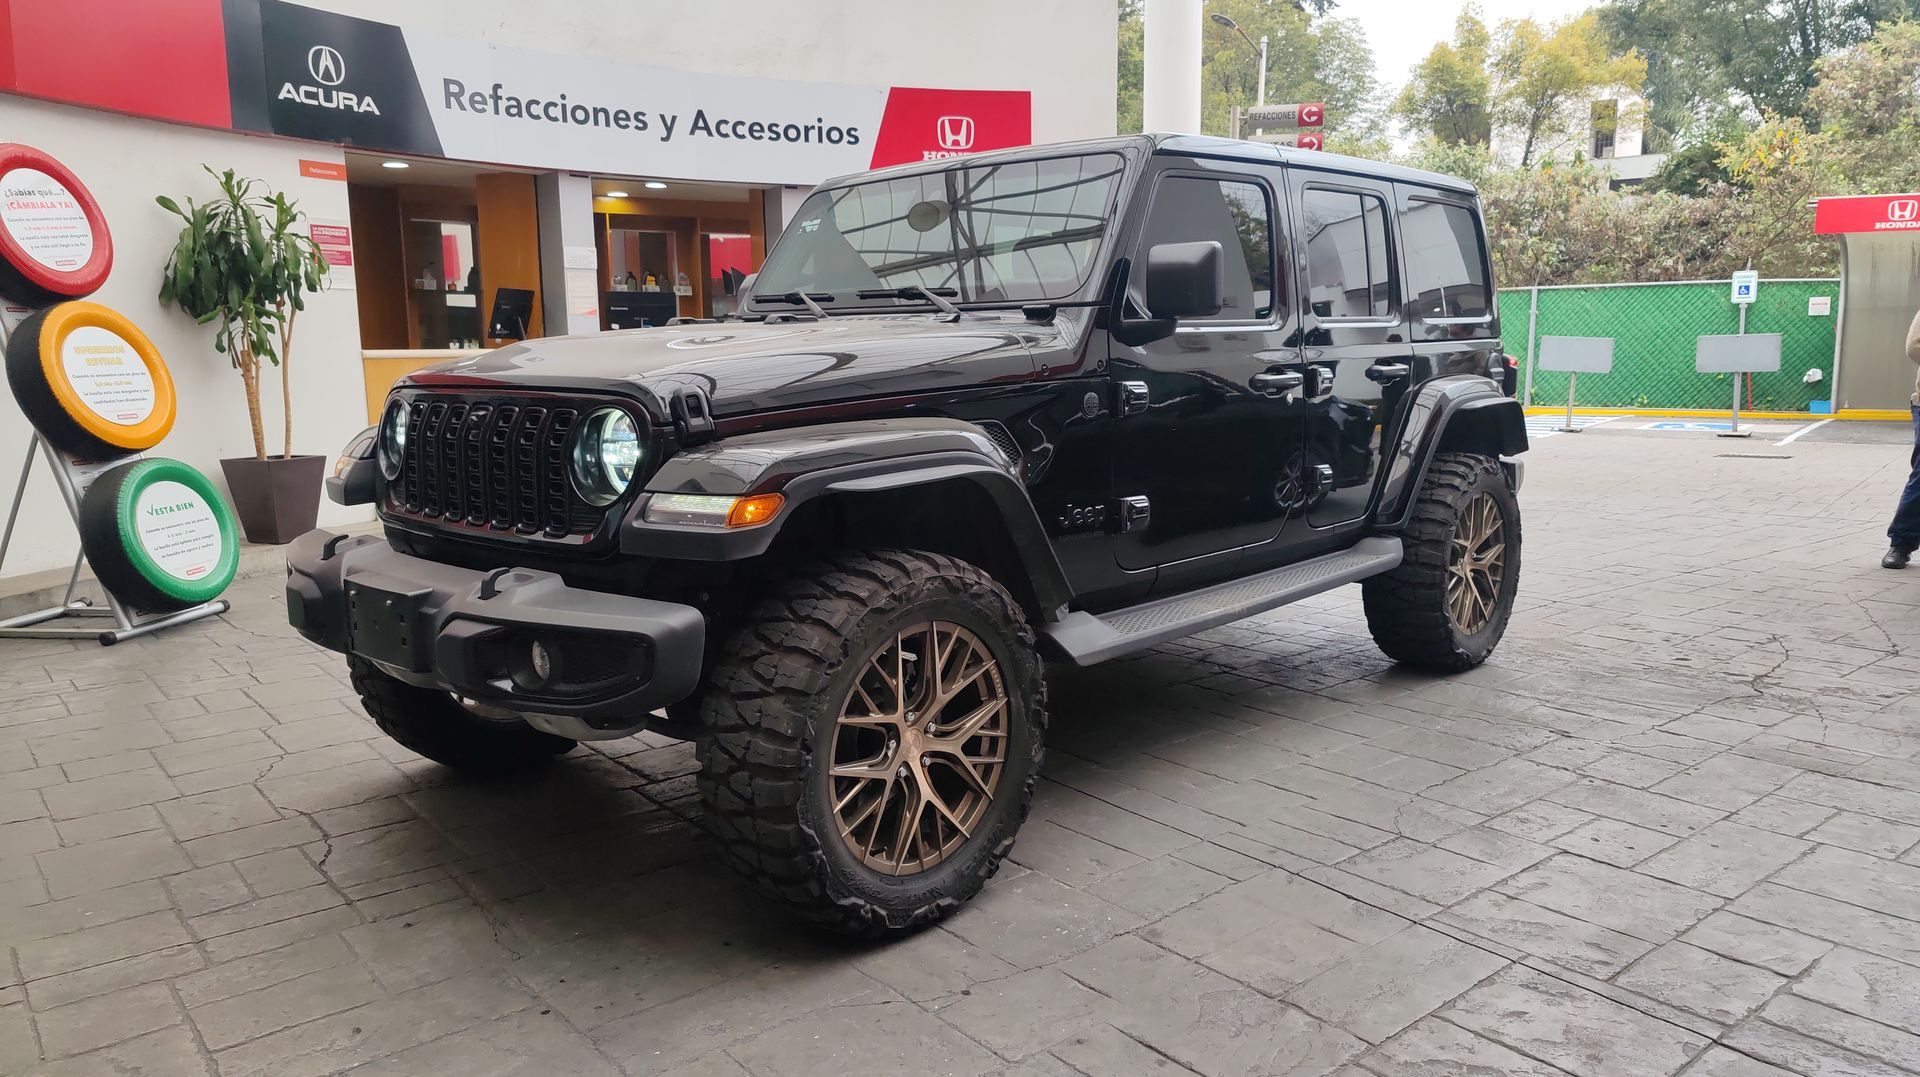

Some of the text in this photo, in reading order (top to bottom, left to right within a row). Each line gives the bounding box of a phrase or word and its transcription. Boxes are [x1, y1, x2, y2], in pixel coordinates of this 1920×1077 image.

[278, 82, 380, 115] ACURA
[443, 77, 860, 145] Refacciones y Accesorios
[1249, 110, 1296, 121] REFACCIONES
[922, 150, 972, 161] HON
[1874, 220, 1920, 229] HOND
[155, 501, 194, 516] ESTA BIEN
[1059, 503, 1105, 526] Jeep
